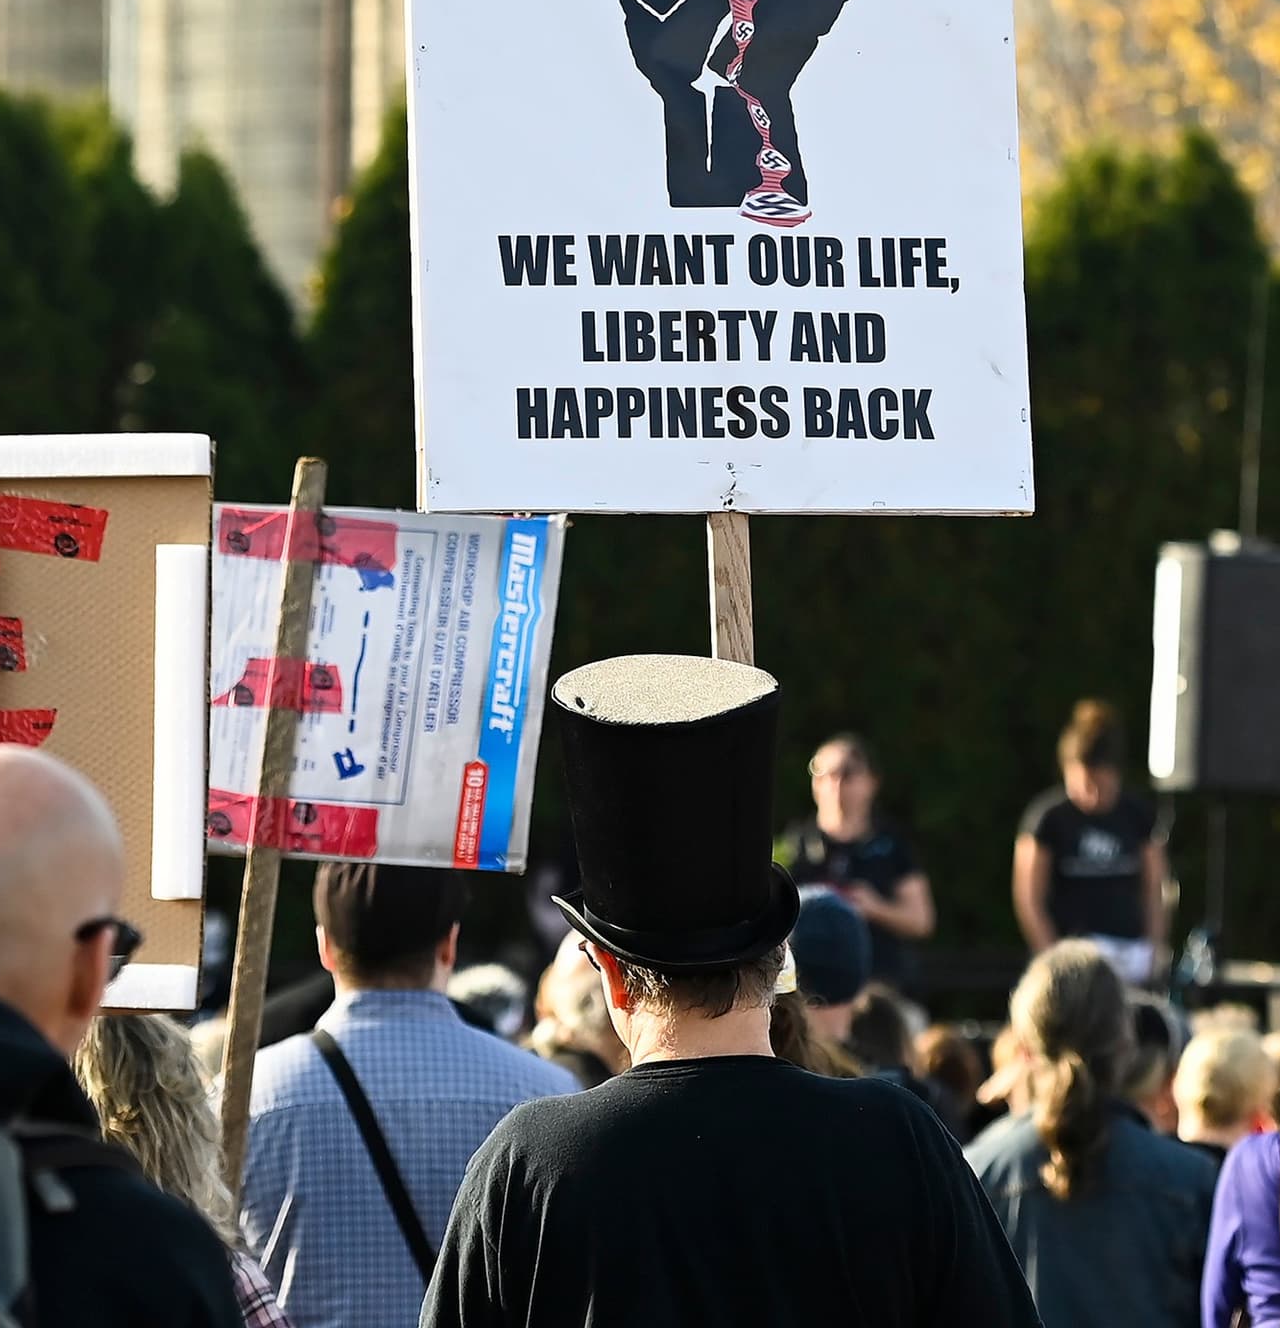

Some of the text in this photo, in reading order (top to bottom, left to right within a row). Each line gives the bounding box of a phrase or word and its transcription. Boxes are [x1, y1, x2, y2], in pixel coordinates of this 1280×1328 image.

[497, 233, 960, 294] WE WANT OUR LIFE,
[581, 310, 886, 364] LIBERTY AND
[516, 385, 935, 441] HAPPINESS BACK
[437, 532, 460, 628] COMPRESSEUR
[446, 534, 481, 725] WORKSHOP AIR COMPRESSOR
[489, 532, 538, 733] Mastercraft
[465, 767, 485, 787] 10
